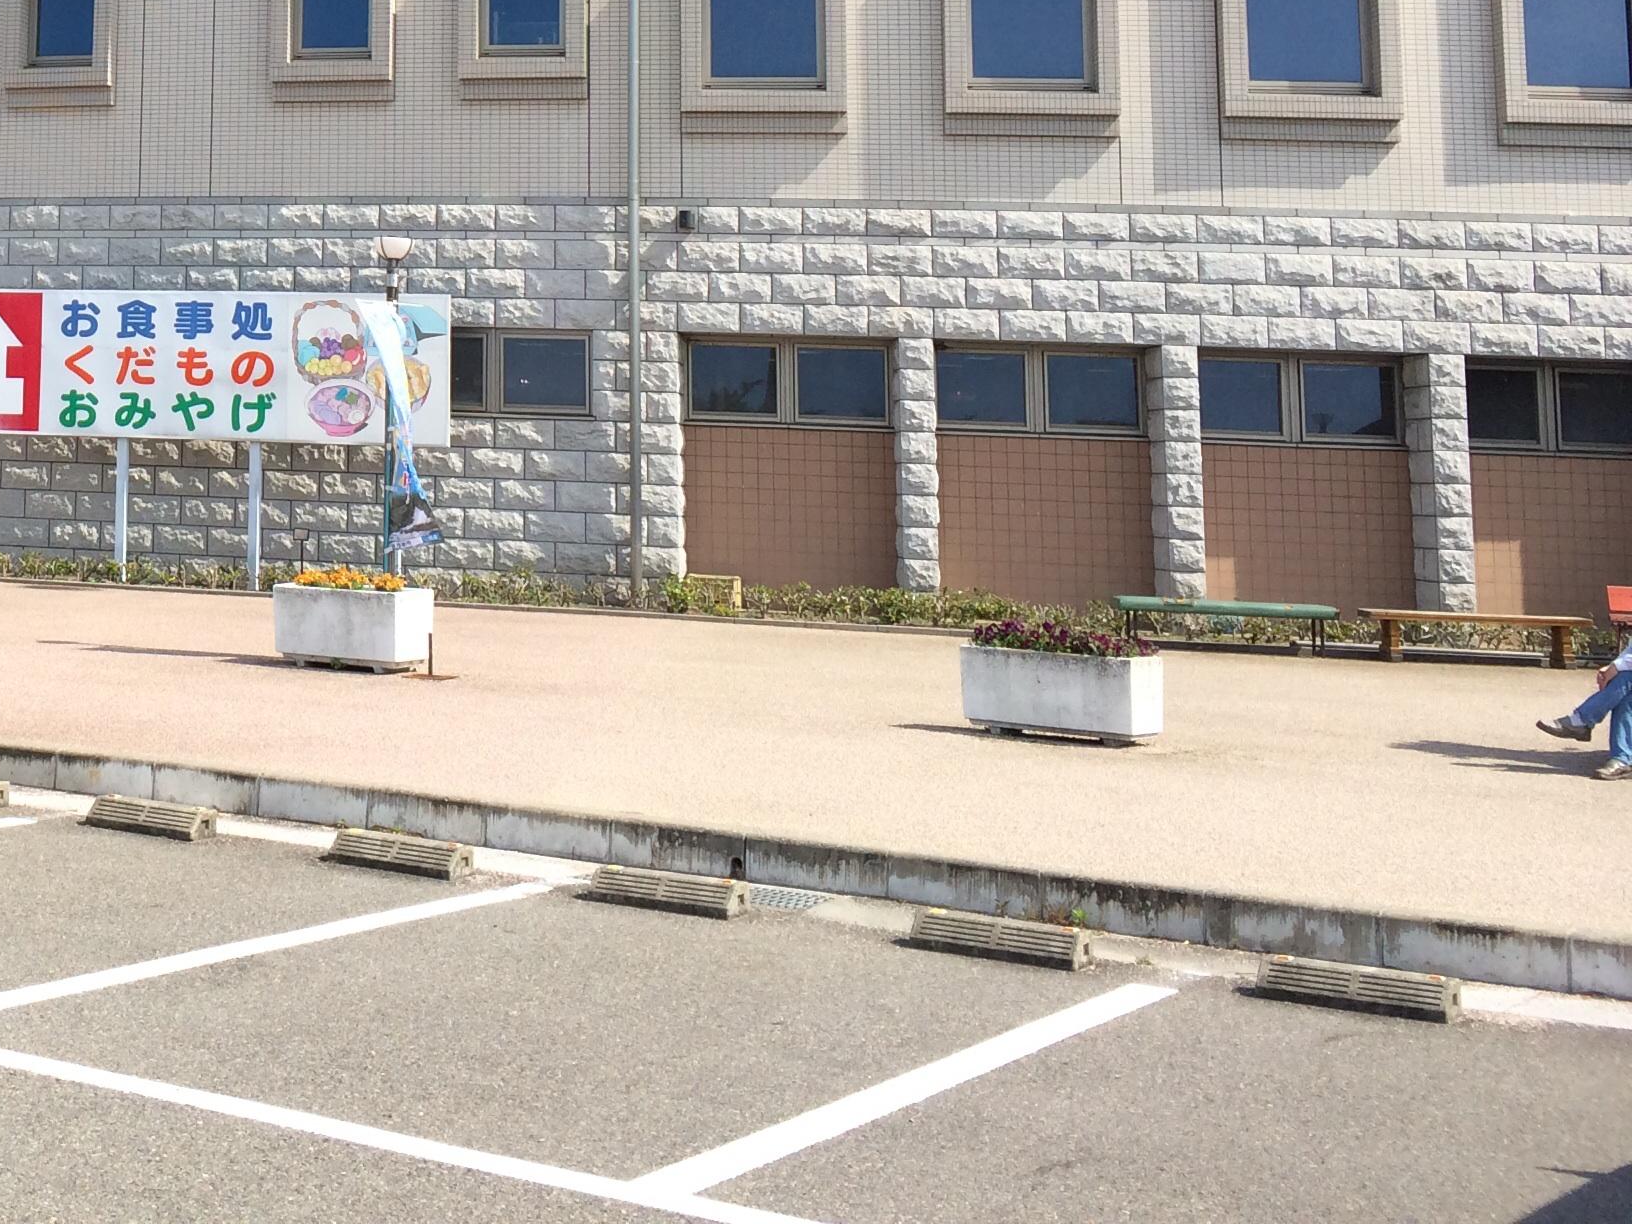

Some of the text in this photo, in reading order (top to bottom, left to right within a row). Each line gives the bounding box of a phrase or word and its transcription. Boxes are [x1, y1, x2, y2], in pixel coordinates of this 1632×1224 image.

[60, 299, 273, 341] お食事処
[64, 344, 275, 386] くだもの
[59, 389, 275, 433] おみやげ
